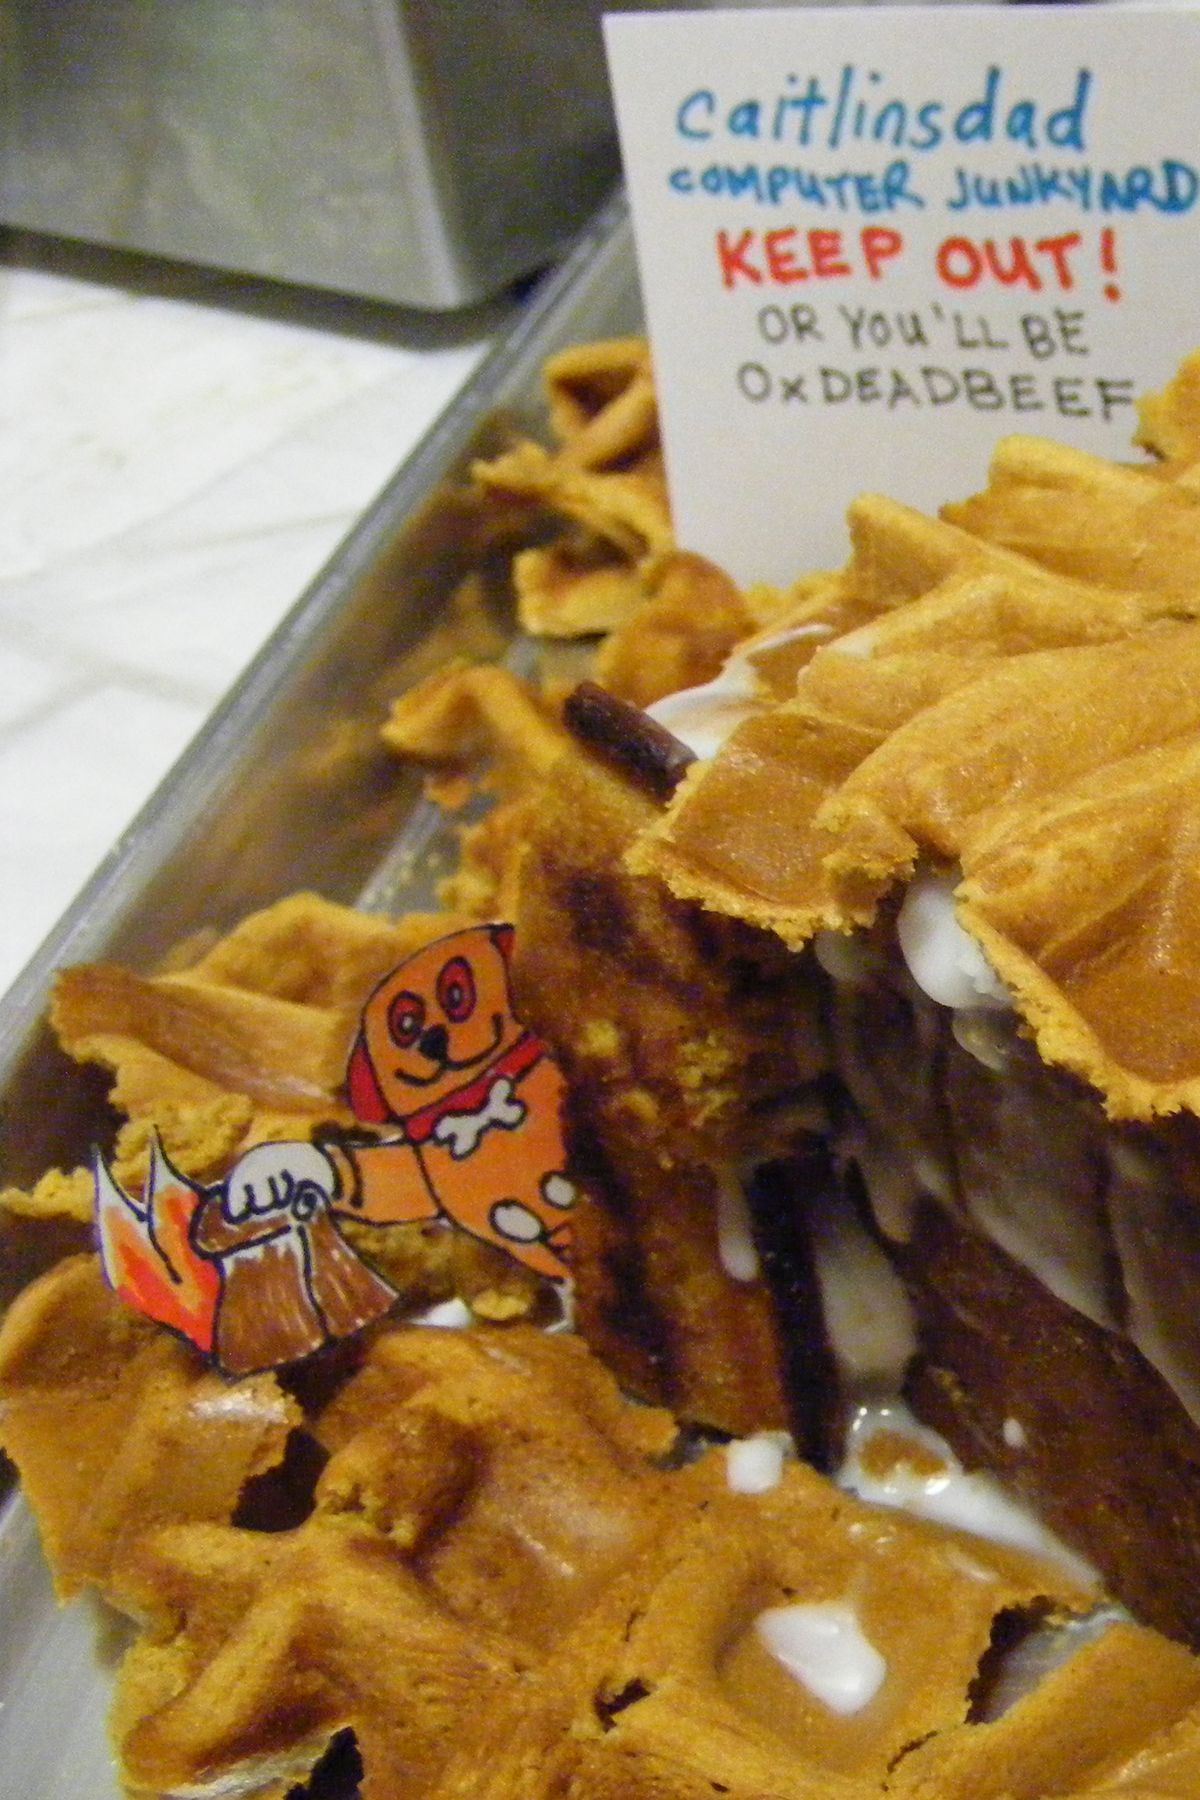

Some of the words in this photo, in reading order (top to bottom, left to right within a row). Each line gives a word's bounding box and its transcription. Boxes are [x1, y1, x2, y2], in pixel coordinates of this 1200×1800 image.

[715, 226, 902, 289] KEEP
[936, 226, 1122, 302] OUT!
[759, 303, 824, 346] OR
[838, 303, 1009, 351] YOU'LL
[1020, 309, 1091, 360] BE
